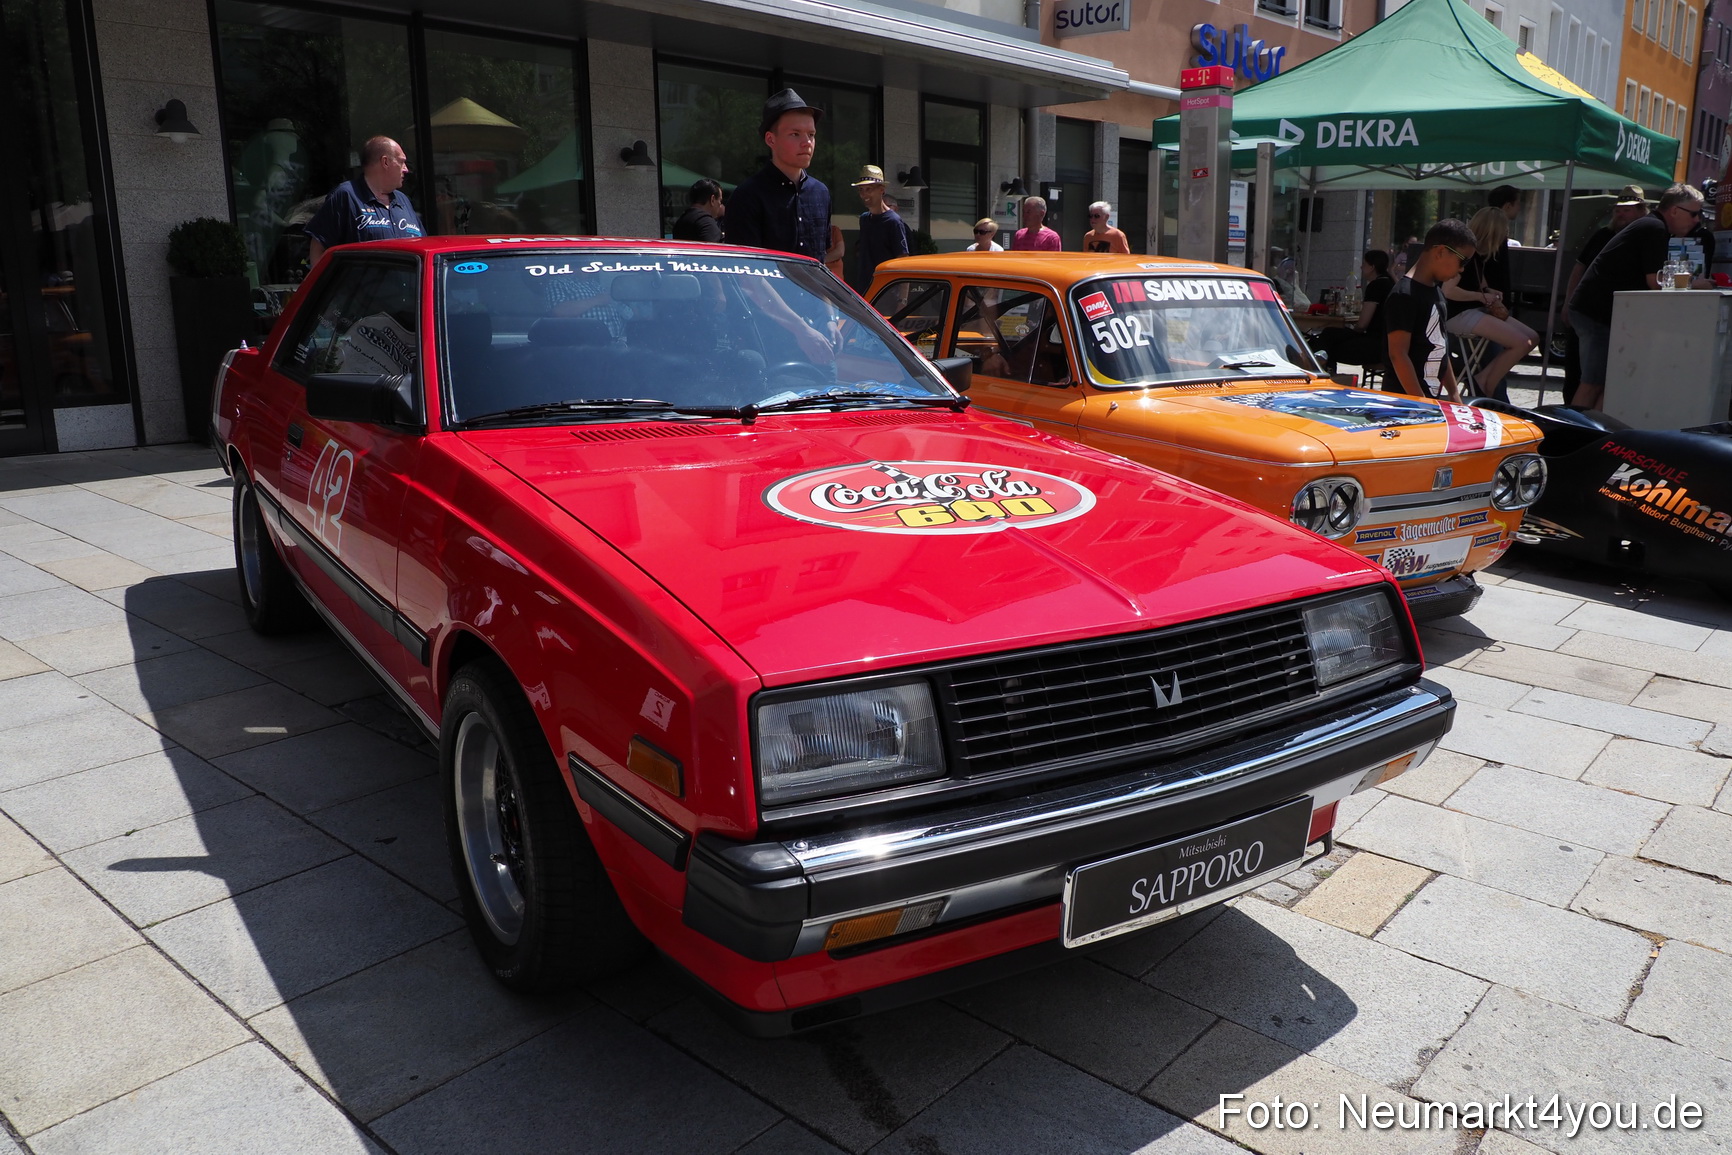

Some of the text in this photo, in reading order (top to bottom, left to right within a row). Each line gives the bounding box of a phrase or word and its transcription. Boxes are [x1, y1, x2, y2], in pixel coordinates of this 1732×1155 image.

[1187, 97, 1210, 106] HotSpot
[1316, 118, 1419, 149] DEKRA
[1626, 132, 1651, 166] DEKRA
[356, 214, 391, 230] Yacht
[457, 264, 484, 272] 061
[525, 261, 784, 279] Old School Mitsubishi
[1143, 280, 1253, 302] SANDTLER
[1085, 300, 1106, 313] DMV
[1091, 315, 1150, 354] 502
[1600, 440, 1689, 484] FAHRSCHULE
[306, 438, 354, 557] 42
[1606, 462, 1732, 538] Kohlma
[894, 497, 1057, 527] 600
[1460, 514, 1486, 524] RAVENOL
[1638, 503, 1670, 522] Altdorf
[1669, 517, 1716, 543] Burgthann
[1359, 531, 1393, 540] RAVENOL
[1476, 534, 1500, 545] RAVENOL
[1391, 554, 1430, 575] KW
[1406, 588, 1438, 597] RAVENOL
[1178, 834, 1227, 860] Mitsubishi
[1129, 840, 1264, 914] SAPPORO
